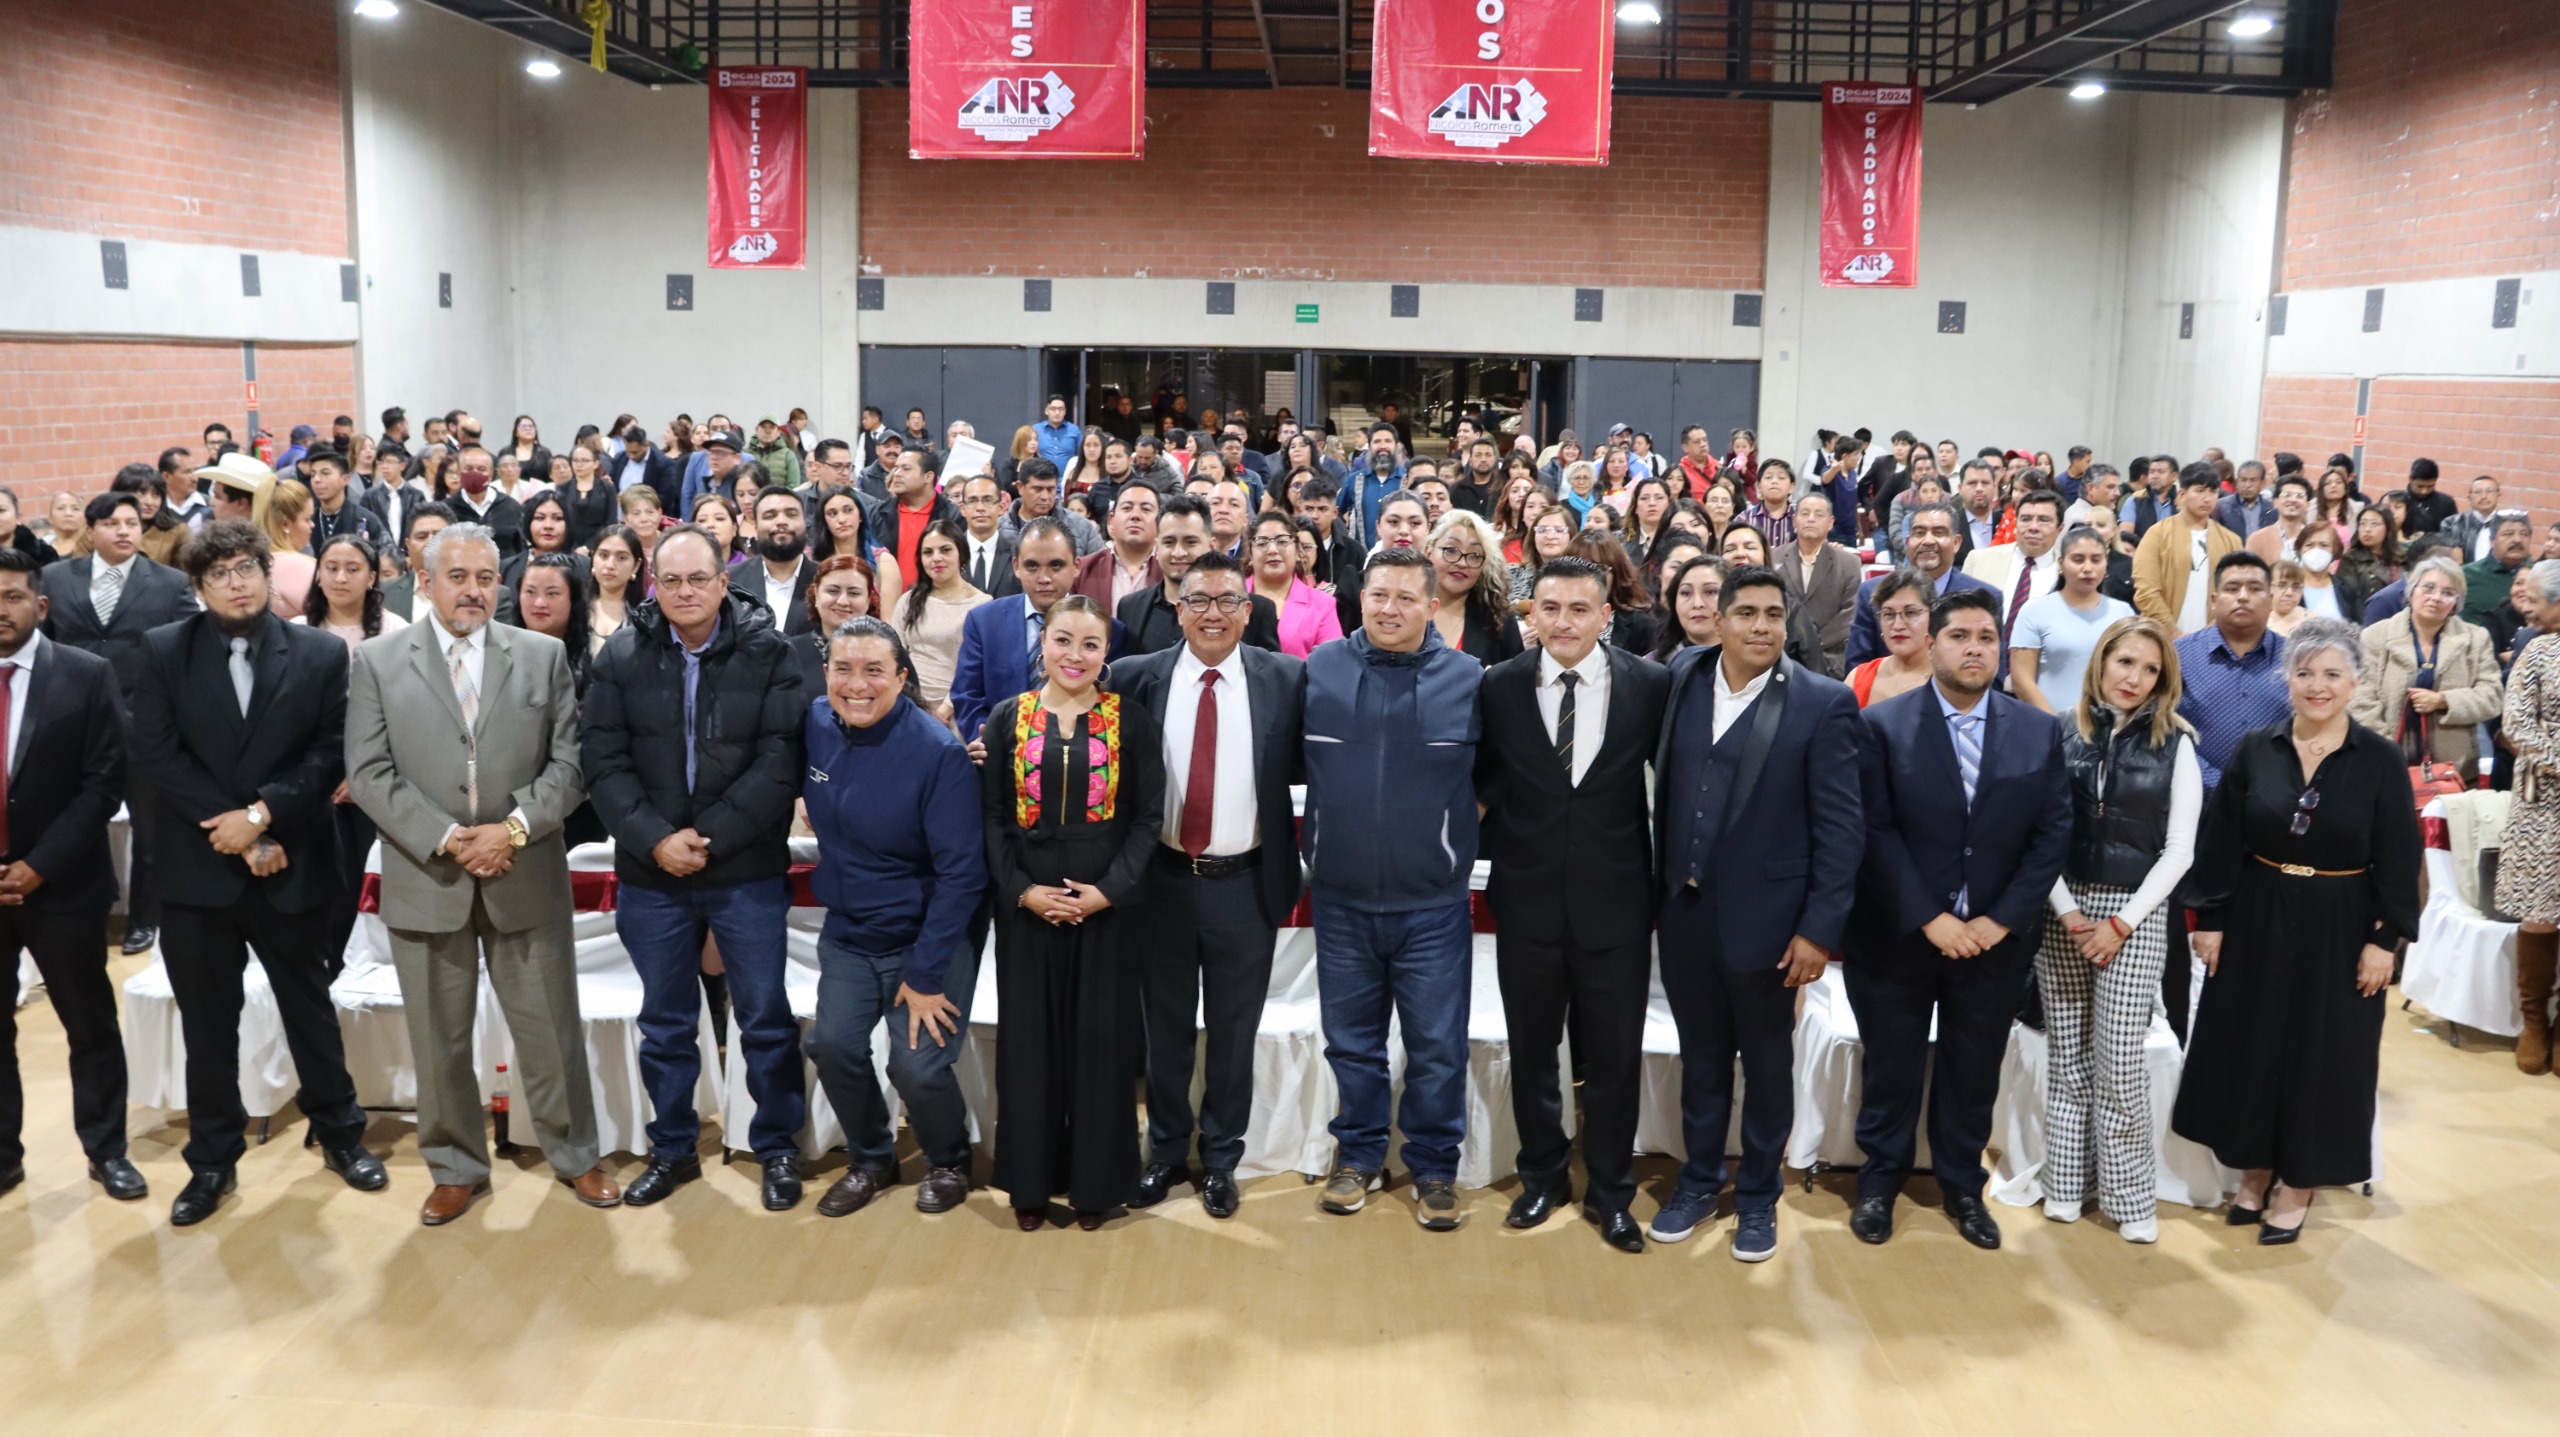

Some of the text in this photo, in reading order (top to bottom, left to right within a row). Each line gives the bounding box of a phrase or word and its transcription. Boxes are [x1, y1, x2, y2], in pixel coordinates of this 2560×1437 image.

[765, 75, 793, 84] 2024
[1880, 91, 1908, 101] 2024
[960, 115, 1051, 125] Nicolás Romero
[1430, 119, 1522, 132] Nicolás Romero
[750, 96, 761, 228] FELICIDADES
[1862, 111, 1877, 246] GRADUADOS
